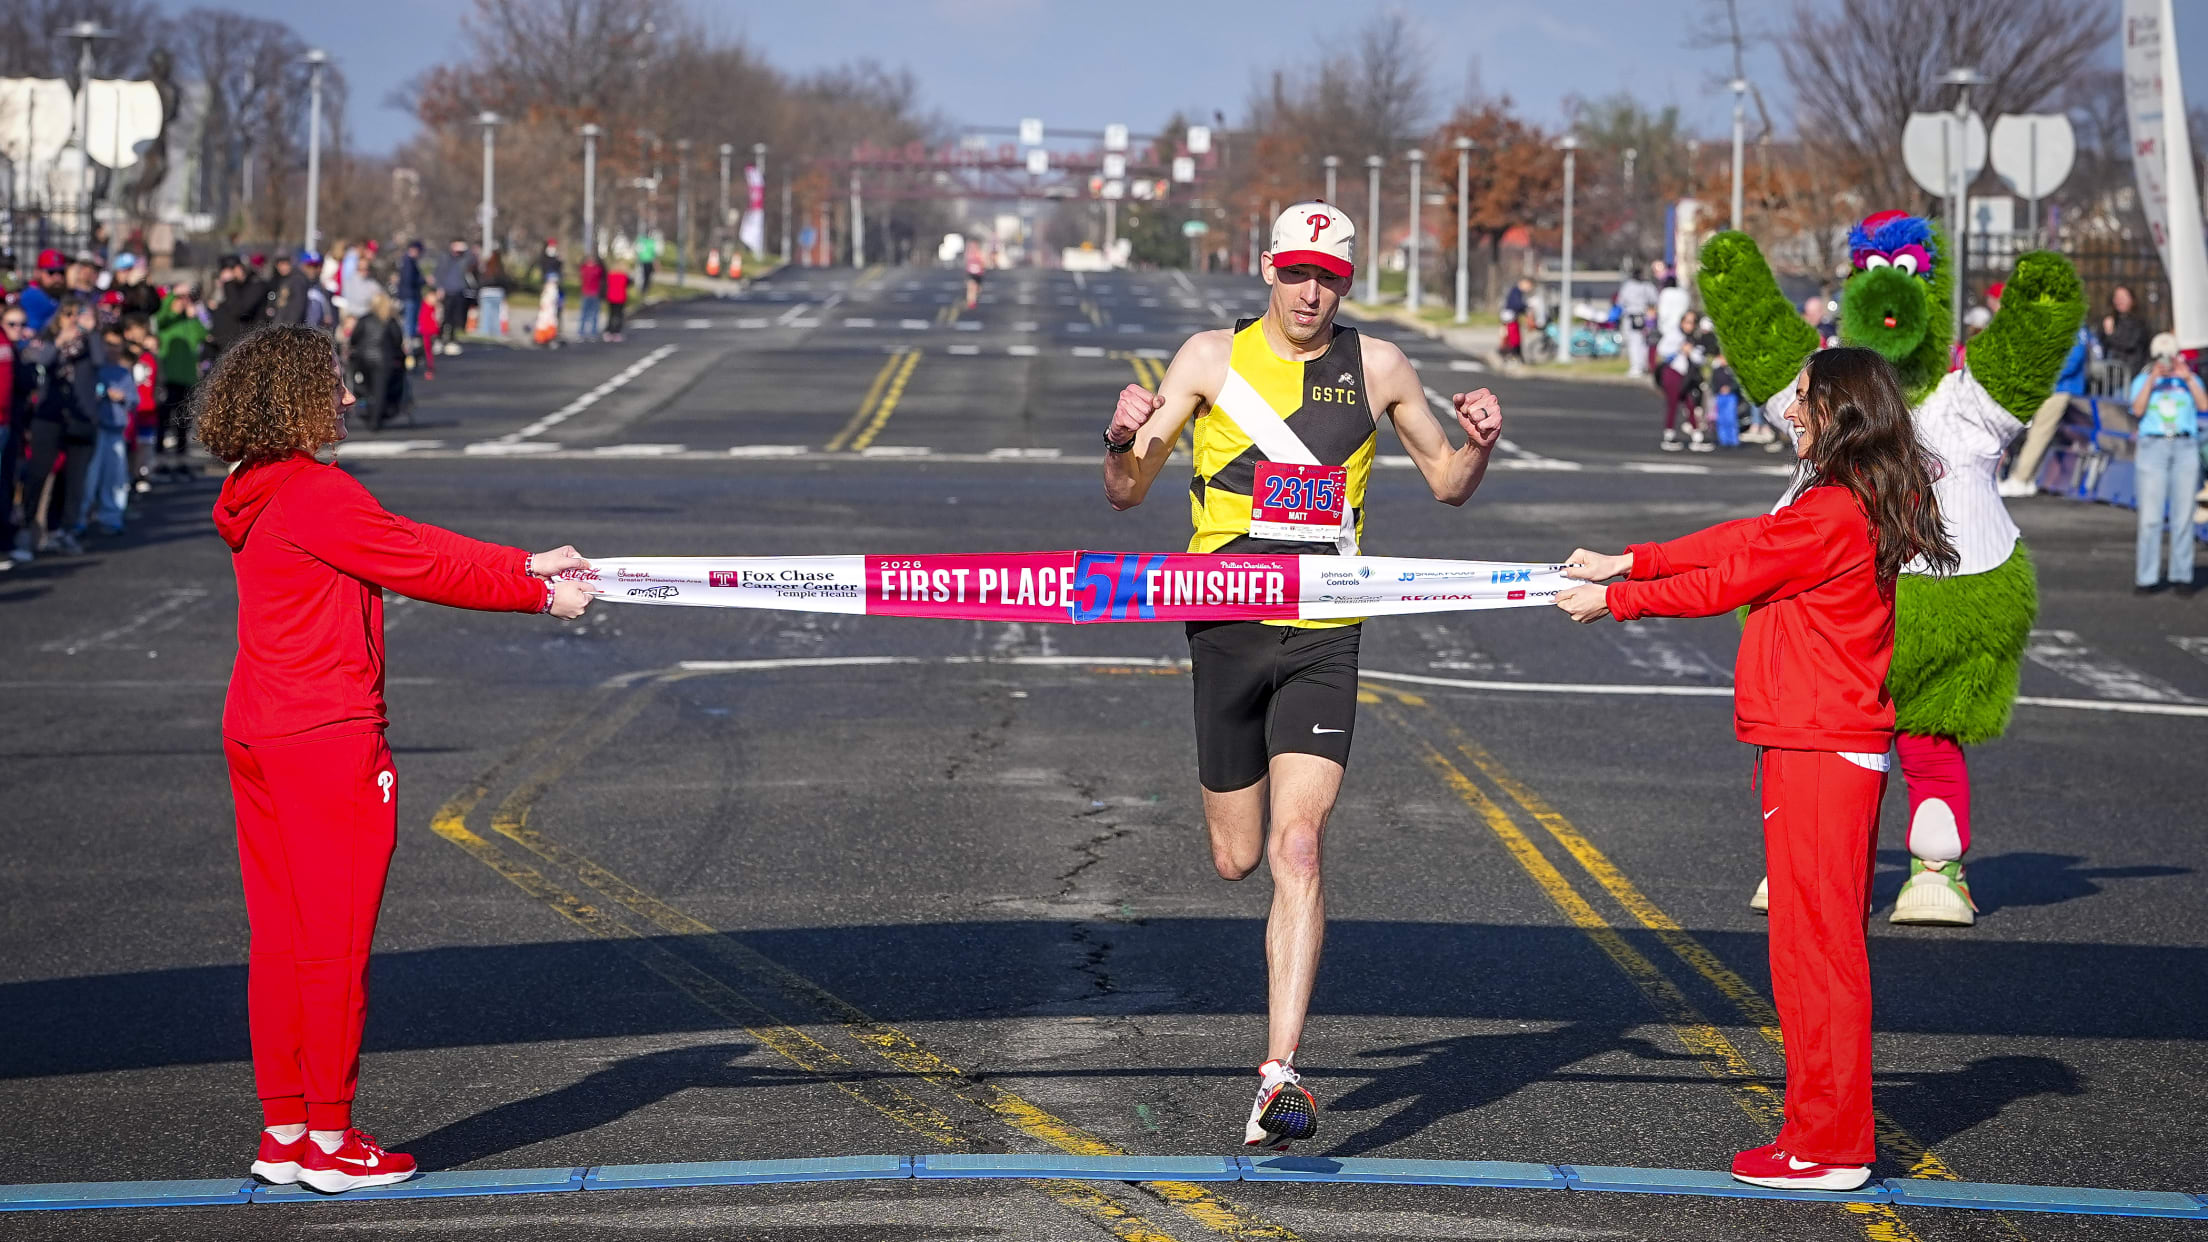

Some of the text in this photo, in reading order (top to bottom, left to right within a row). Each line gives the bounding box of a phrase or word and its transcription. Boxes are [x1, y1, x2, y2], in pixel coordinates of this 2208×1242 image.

[1306, 214, 1331, 242] P
[1312, 386, 1356, 405] GSTC
[1264, 475, 1334, 511] 2315
[1288, 511, 1308, 520] MATT
[881, 561, 922, 569] 2026
[1220, 561, 1243, 569] Phillies
[743, 570, 835, 582] Fox Chase
[1321, 571, 1353, 579] Johnson
[1491, 569, 1532, 584] IBX
[742, 582, 858, 591] Cancer Center
[881, 567, 1074, 607] FIRST PLACE
[1070, 553, 1169, 622] 5K
[1146, 569, 1285, 606] FINISHER
[776, 590, 817, 599] Temple
[378, 771, 394, 803] P
